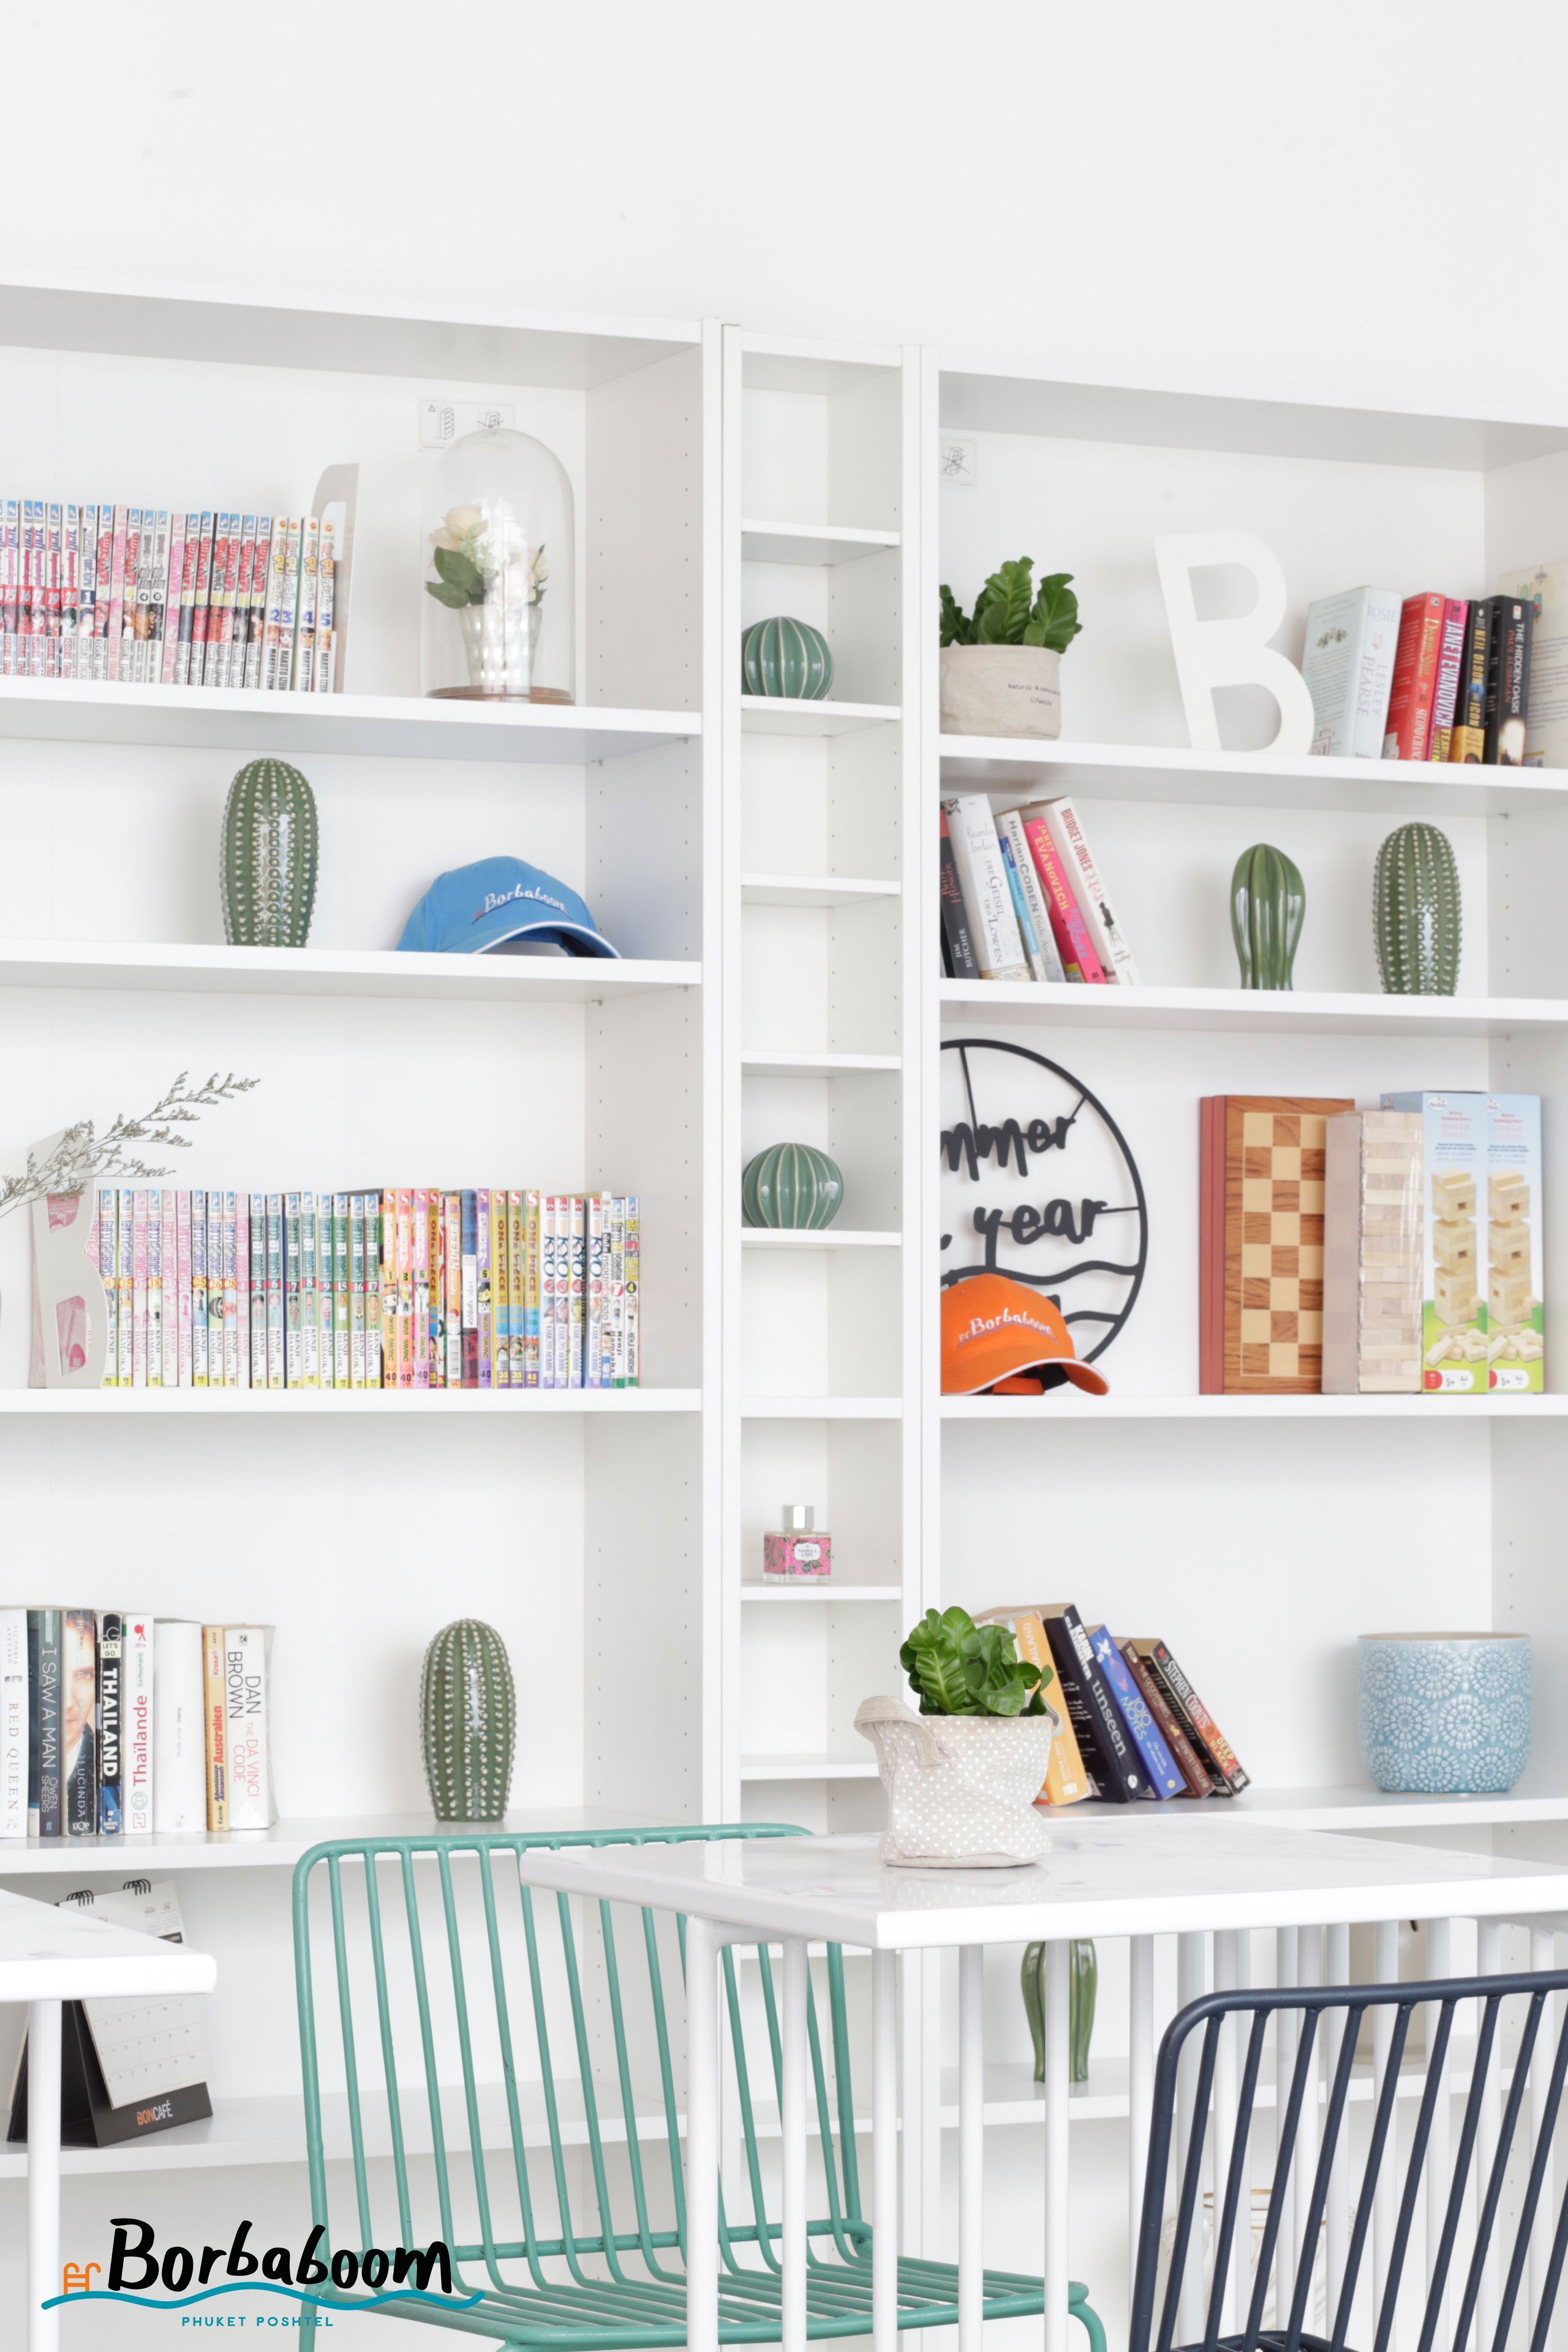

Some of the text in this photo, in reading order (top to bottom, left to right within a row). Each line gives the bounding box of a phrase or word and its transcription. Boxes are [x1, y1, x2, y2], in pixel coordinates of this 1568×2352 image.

[5, 590, 17, 601] 15
[48, 592, 59, 605] 19
[85, 592, 91, 603] 1
[270, 609, 280, 623] 2
[282, 611, 292, 624] 3
[303, 611, 313, 624] 4
[321, 614, 331, 626] 5
[1474, 630, 1487, 649] NEIL
[266, 648, 277, 690] MAKOTO IZUM
[280, 650, 289, 676] MAKOTO
[301, 650, 311, 676] MAKOTO
[1435, 620, 1464, 726] JANET EVANOVICH
[1471, 653, 1485, 685] OLSON
[1511, 623, 1525, 714] THE HIDDEN OASIS
[1357, 655, 1375, 717] PEARSE
[1371, 664, 1387, 718] LESLEY
[1468, 703, 1481, 726] ICON
[970, 839, 996, 854] Jordan
[1037, 824, 1055, 853] JANET
[1060, 807, 1093, 873] BRIDGET JONES
[1009, 820, 1025, 862] Harlan
[1020, 863, 1040, 913] COBEN
[1034, 837, 1069, 911] EVANOVICH
[484, 883, 568, 915] Borbaboom
[945, 863, 961, 905] HUNGER
[985, 860, 1005, 916] DIE GEISEL
[1012, 871, 1024, 901] PHUKET
[984, 899, 992, 917] DES
[963, 928, 973, 968] BUTCHER
[940, 1116, 1076, 1182] mmer
[973, 1198, 1108, 1267] year
[543, 1235, 555, 1276] KYO
[557, 1235, 568, 1277] KYO
[571, 1235, 582, 1276] KYO
[105, 1280, 112, 1288] 8
[122, 1278, 132, 1288] 15
[150, 1278, 160, 1288] 18
[212, 1280, 221, 1289] 26
[227, 1279, 236, 1289] 28
[255, 1281, 262, 1289] 5
[271, 1280, 277, 1289] 6
[291, 1283, 296, 1292] 7
[306, 1278, 312, 1287] 8
[324, 1282, 330, 1291] 9
[338, 1282, 347, 1291] 15
[354, 1283, 363, 1292] 16
[369, 1281, 377, 1290] 17
[614, 1284, 621, 1294] 7
[628, 1283, 633, 1292] 4
[968, 1308, 1054, 1338] Borbaboom
[1021, 1622, 1042, 1670] AILAND
[1074, 1624, 1095, 1662] KARIN
[42, 1662, 56, 1703] SAW
[228, 1651, 244, 1719] BROWN
[246, 1676, 261, 1714] DAN
[1164, 1660, 1191, 1699] STEPHEN
[1185, 1695, 1210, 1730] COONTS
[42, 1708, 56, 1721] A
[103, 1668, 118, 1777] THAILAND
[1093, 1679, 1126, 1758] unseen
[1120, 1695, 1147, 1741] MOYES
[1133, 1696, 1153, 1727] JOJO
[42, 1727, 56, 1768] MAN
[133, 1695, 148, 1787] Thaïlande
[213, 1705, 223, 1763] Australien
[1217, 1736, 1234, 1762] DEEP
[6, 1703, 19, 1810] RED QUEEN
[233, 1745, 245, 1782] CODE
[246, 1740, 258, 1760] DA
[1209, 1740, 1230, 1770] BLACK
[77, 1759, 86, 1818] LUCINDA
[246, 1762, 260, 1797] VINCI
[72, 1822, 89, 1831] UQP
[137, 2100, 173, 2127] BONCAFÉ
